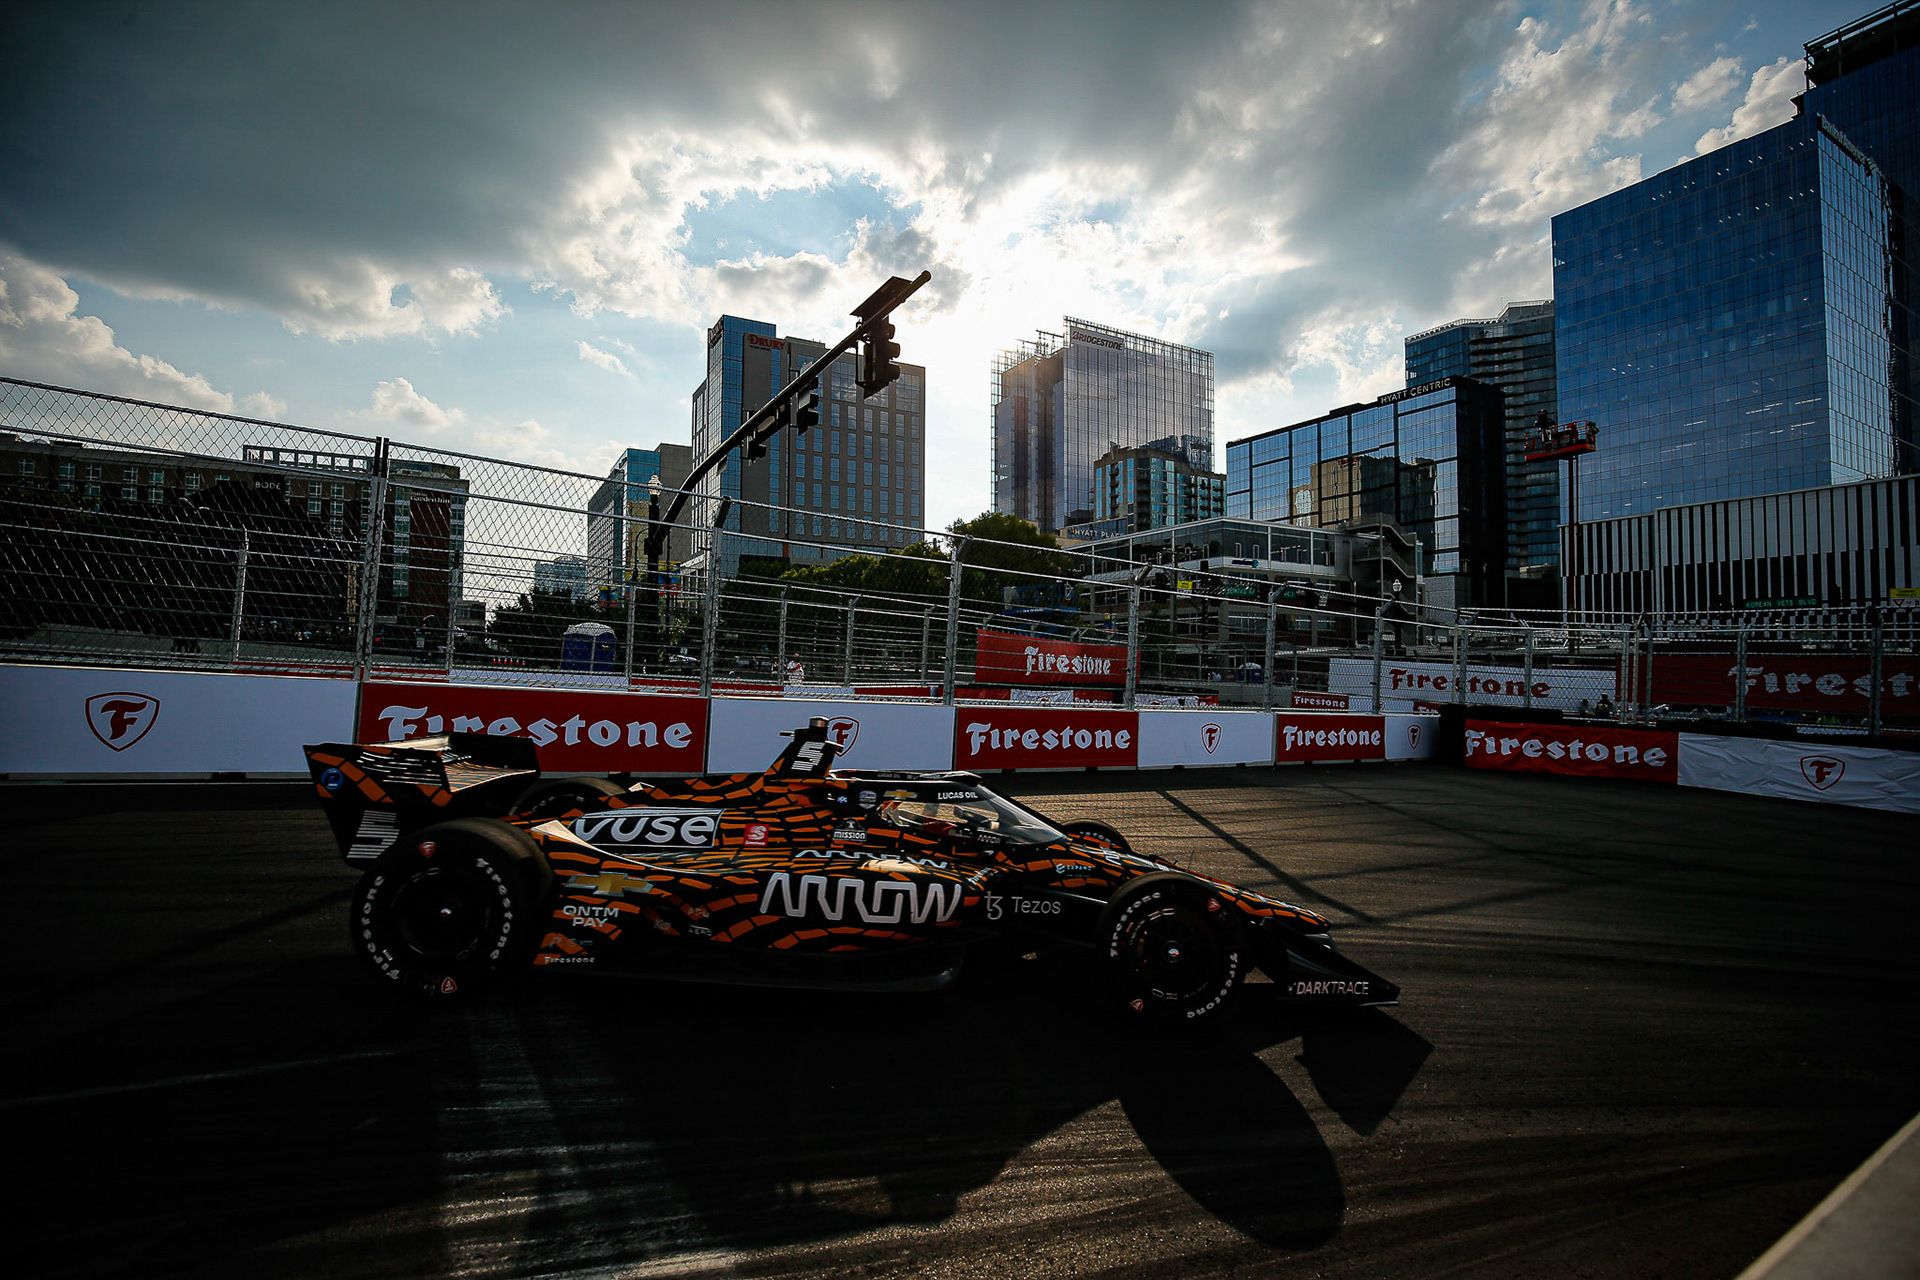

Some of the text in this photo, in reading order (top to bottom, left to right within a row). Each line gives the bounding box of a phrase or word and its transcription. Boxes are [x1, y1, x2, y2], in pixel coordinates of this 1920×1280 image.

[748, 334, 785, 350] DRURY
[1072, 331, 1123, 351] BRIDGESTONE
[1380, 377, 1452, 404] HYATT CENTRIC
[254, 480, 281, 490] BODE
[1074, 528, 1098, 538] HYATT
[1746, 598, 1818, 608] KOREAN VETS BLVD
[1023, 645, 1111, 676] Firestone
[1294, 695, 1347, 709] Firestone
[378, 705, 693, 749] Firestone
[965, 722, 1131, 755] Firestone
[1282, 725, 1382, 752] Firestone
[791, 741, 825, 771] 5
[1465, 729, 1668, 768] Firestone
[937, 791, 978, 800] LUCAS OIL
[575, 816, 715, 846] vuse
[759, 872, 963, 924] ARROW
[1011, 896, 1062, 914] Tezos
[562, 905, 619, 918] QNTM
[571, 917, 609, 928] PAY
[1296, 981, 1370, 995] DARKTRACE
